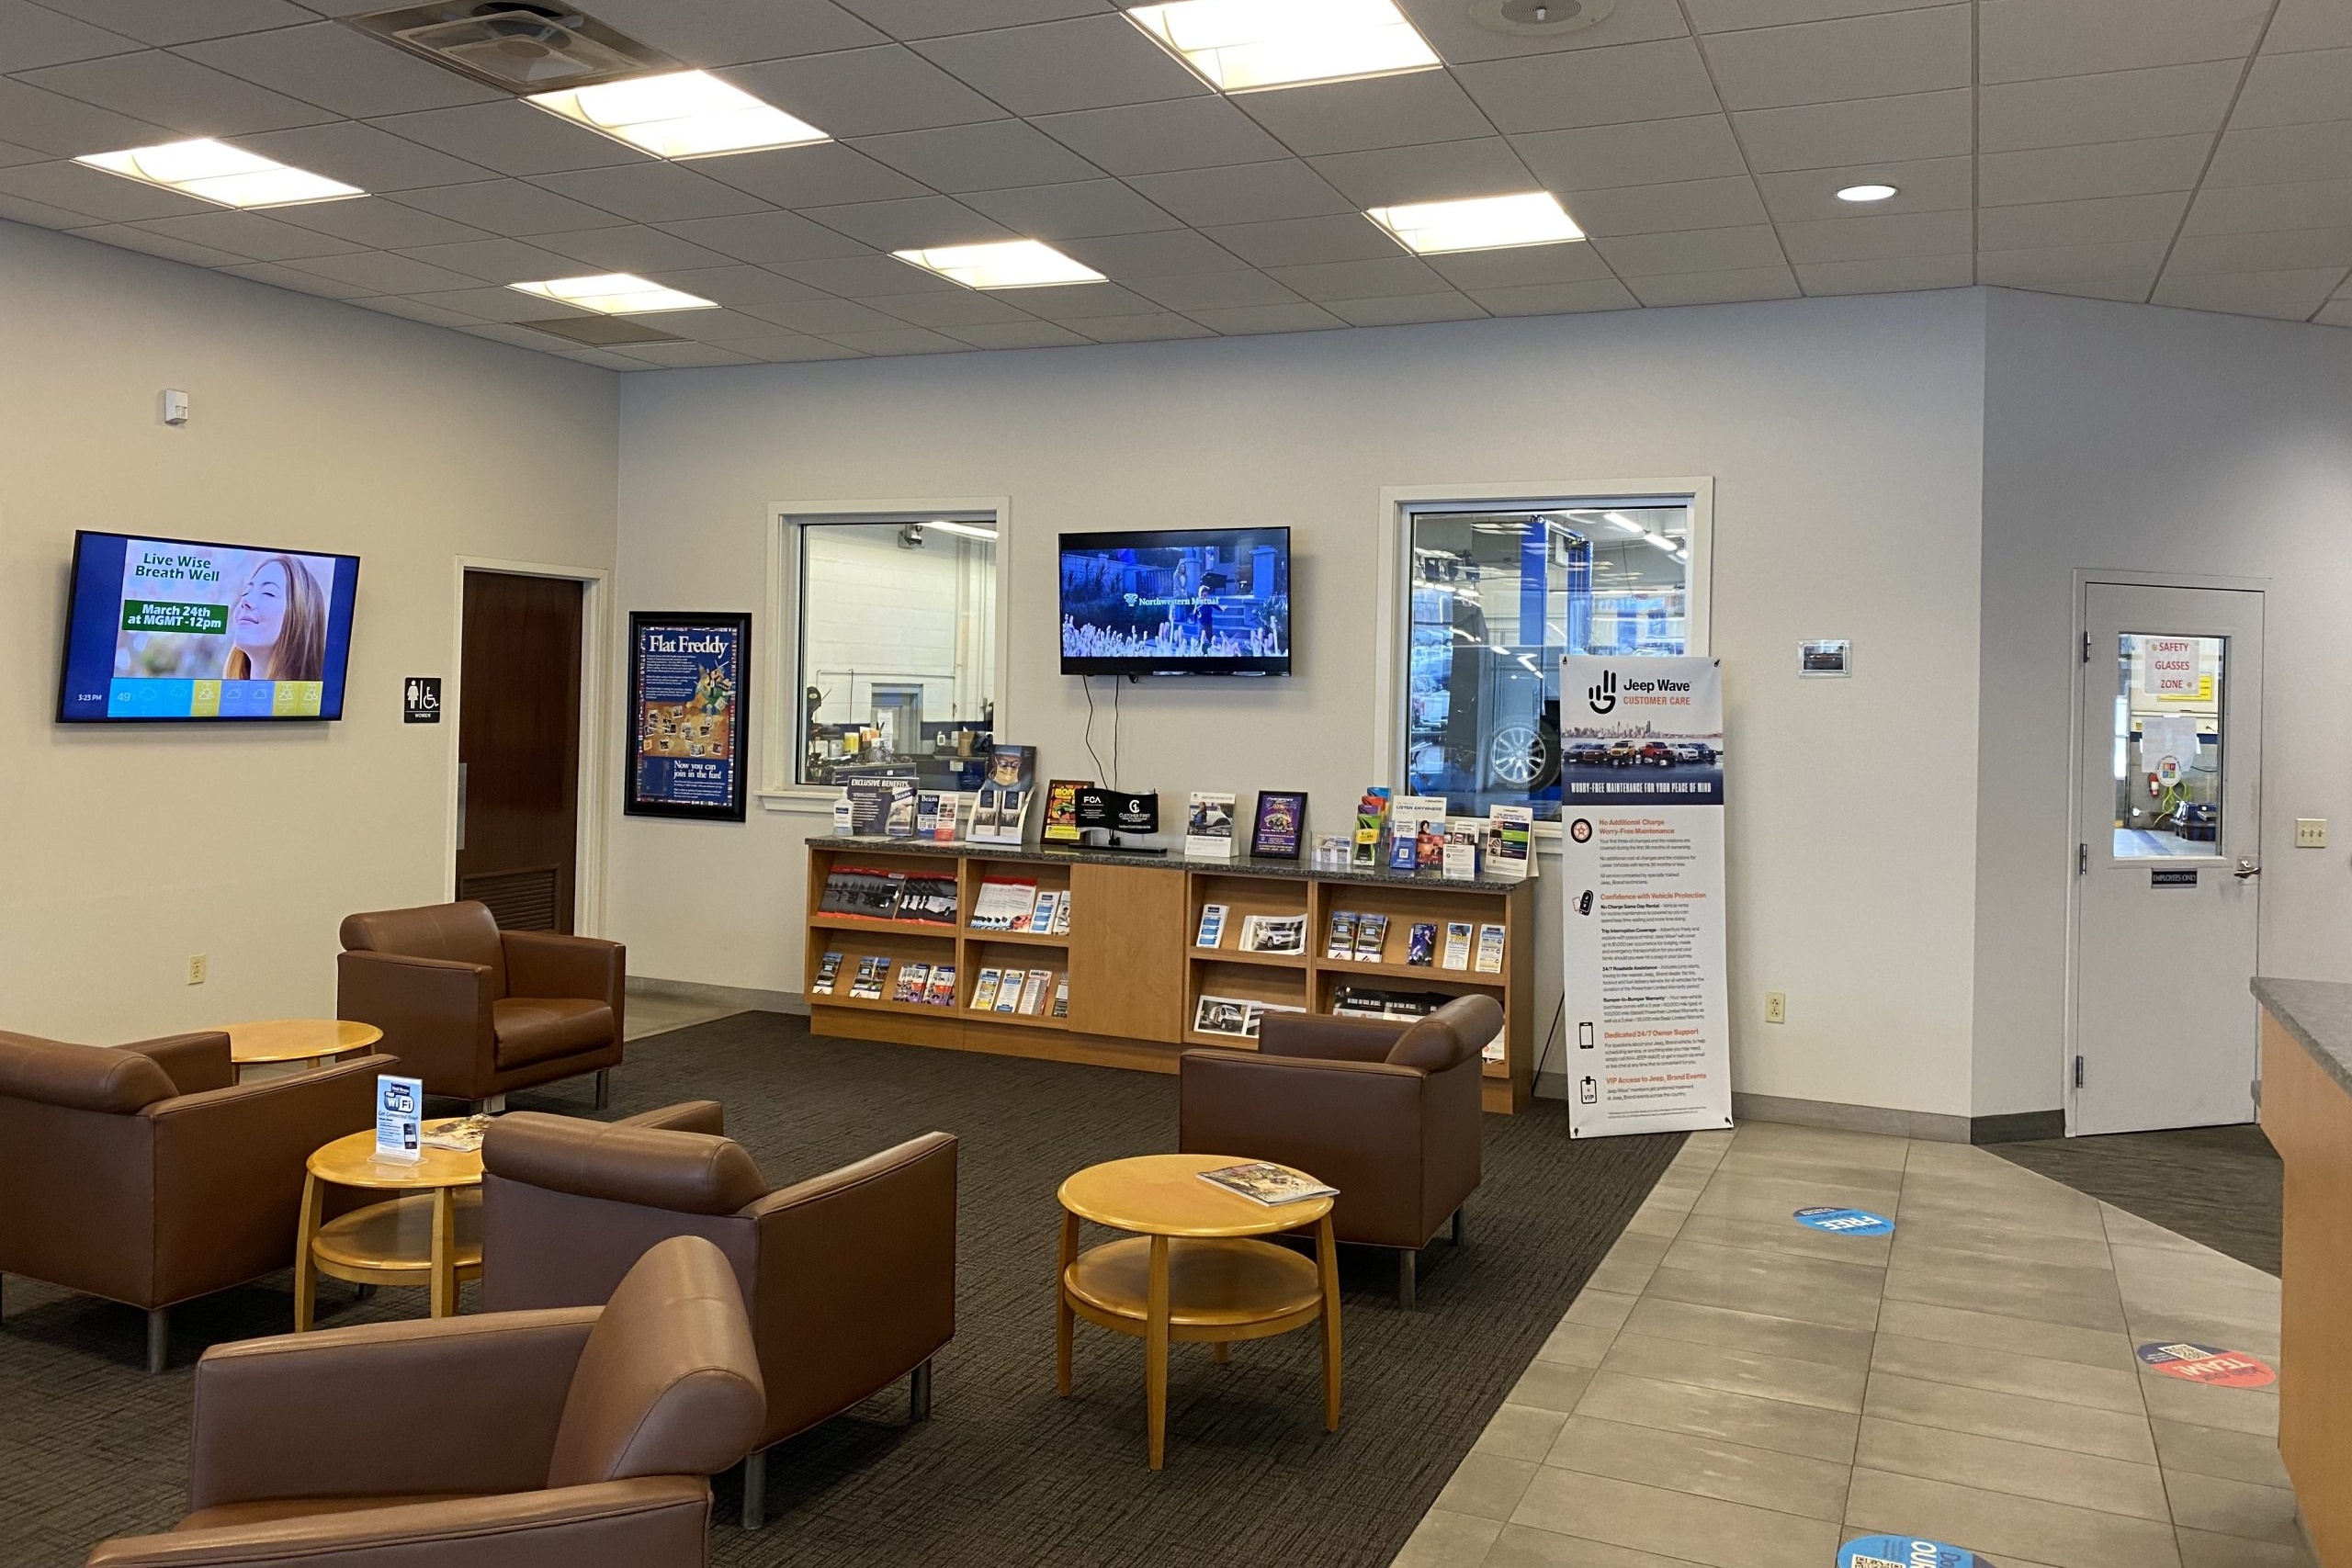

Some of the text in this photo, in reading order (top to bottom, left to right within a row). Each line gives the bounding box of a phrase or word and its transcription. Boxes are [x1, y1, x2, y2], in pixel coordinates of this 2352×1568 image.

[143, 553, 211, 569] Live Wise
[135, 565, 220, 581] Breath Well
[1138, 597, 1190, 606] Northwestern
[141, 604, 210, 617] March 24th
[128, 615, 141, 625] at
[143, 615, 184, 626] MGMT
[649, 635, 729, 660] Flat Freddy
[2159, 642, 2188, 651] SAFETY
[2154, 660, 2190, 671] GLASSES
[1623, 678, 1655, 694] Jeep
[2160, 679, 2184, 689] ZONE
[1623, 696, 1691, 705] CUSTOMER CARE
[673, 760, 689, 769] Now
[691, 763, 703, 772] you
[673, 769, 686, 780] join
[687, 769, 695, 778] in
[696, 770, 707, 779] the
[851, 778, 880, 787] EXCLUSIVE
[1671, 782, 1688, 793] PEACE
[1642, 818, 1665, 827] Charge
[1599, 828, 1634, 836] Worry-Free
[1673, 1028, 1699, 1036] Support
[1815, 1215, 1883, 1230] FREE
